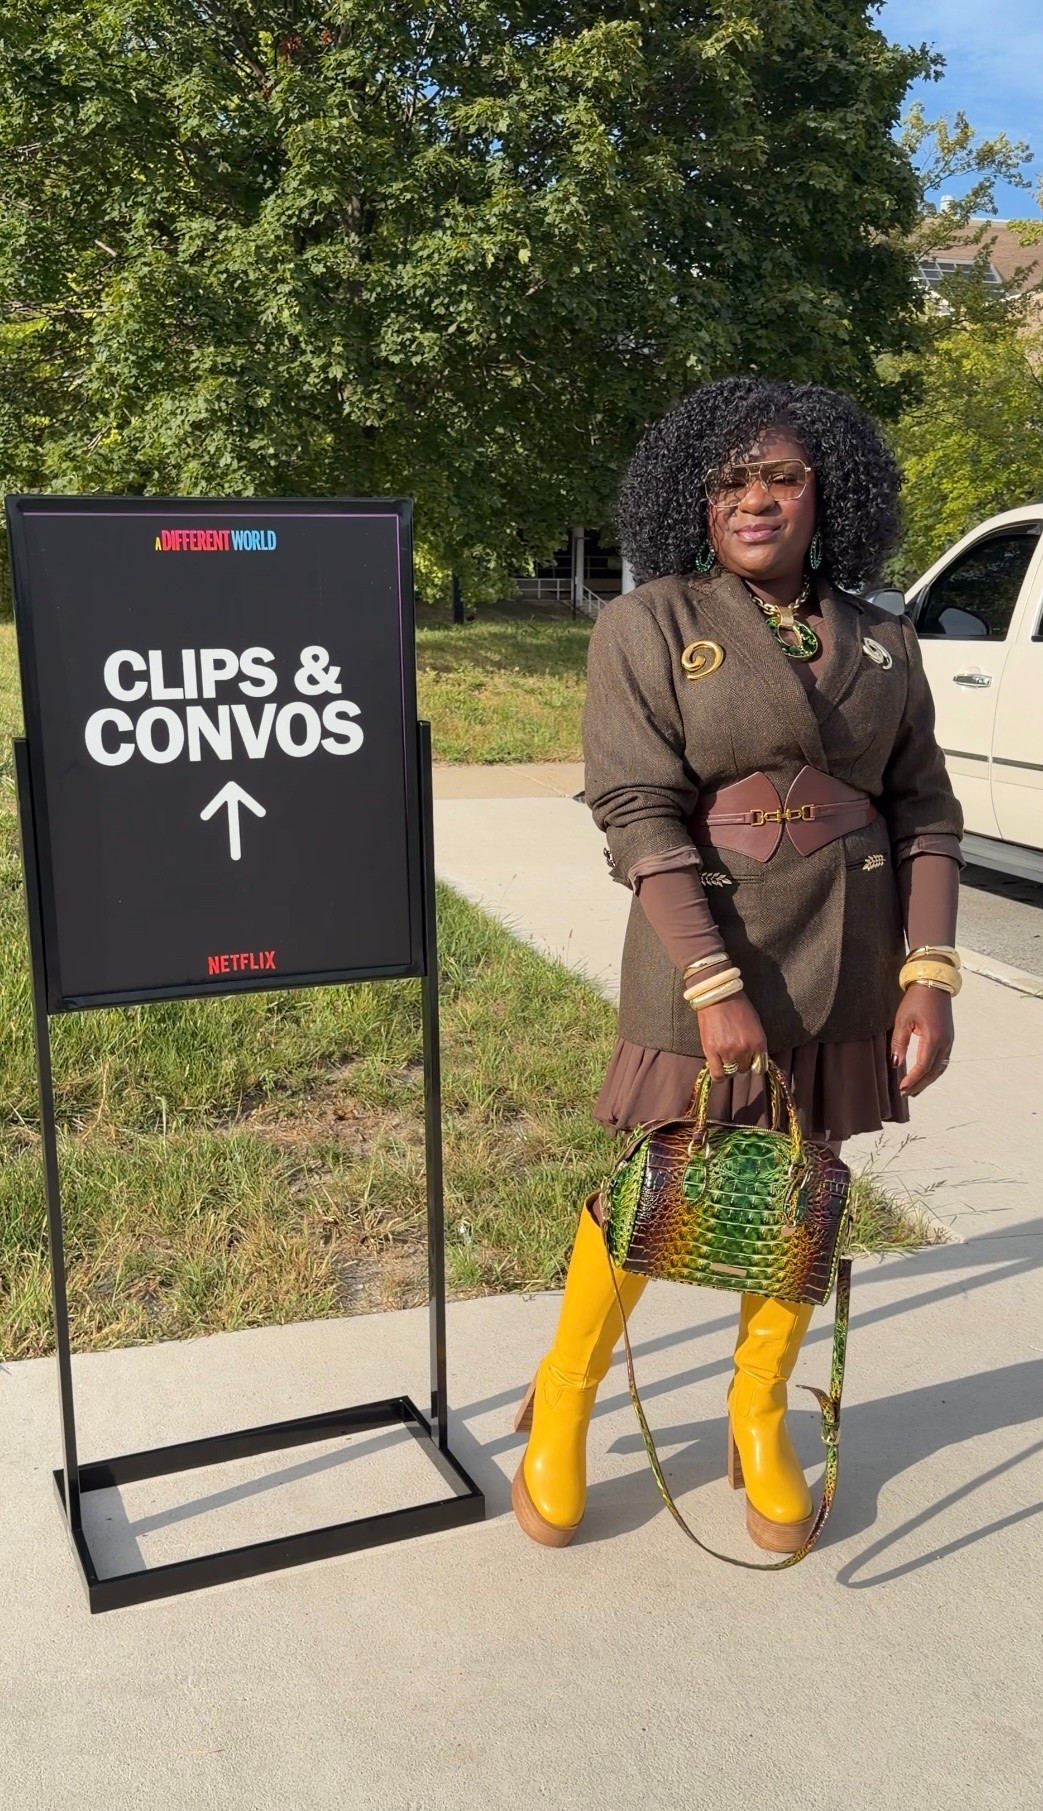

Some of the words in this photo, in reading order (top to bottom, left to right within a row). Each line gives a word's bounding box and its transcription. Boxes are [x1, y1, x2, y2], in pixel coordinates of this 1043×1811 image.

[155, 537, 162, 551] A
[161, 530, 230, 551] DIFFERENT
[231, 530, 277, 551] WORLD
[103, 646, 278, 702] CLIPS
[294, 645, 343, 696] &
[84, 699, 364, 767] CONVOS
[207, 950, 277, 976] NETFLIX
